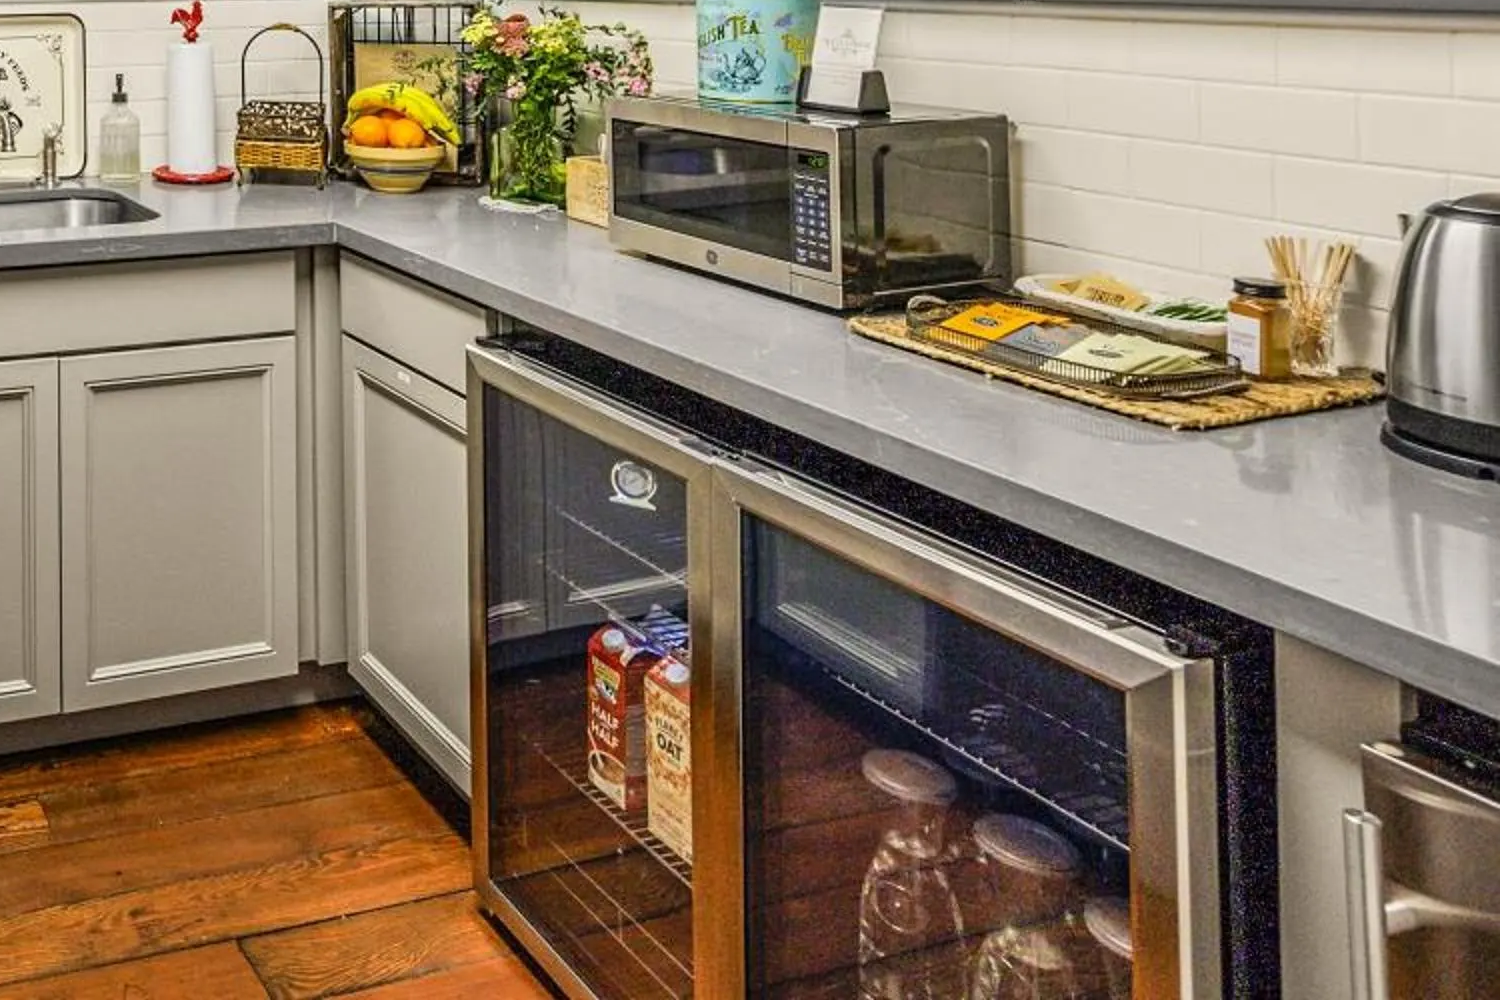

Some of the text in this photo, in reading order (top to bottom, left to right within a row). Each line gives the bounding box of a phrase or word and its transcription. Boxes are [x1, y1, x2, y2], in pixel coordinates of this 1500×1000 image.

[724, 15, 759, 40] TEA
[591, 701, 619, 730] HALF
[591, 720, 620, 749] HALF
[656, 733, 685, 762] OAT
